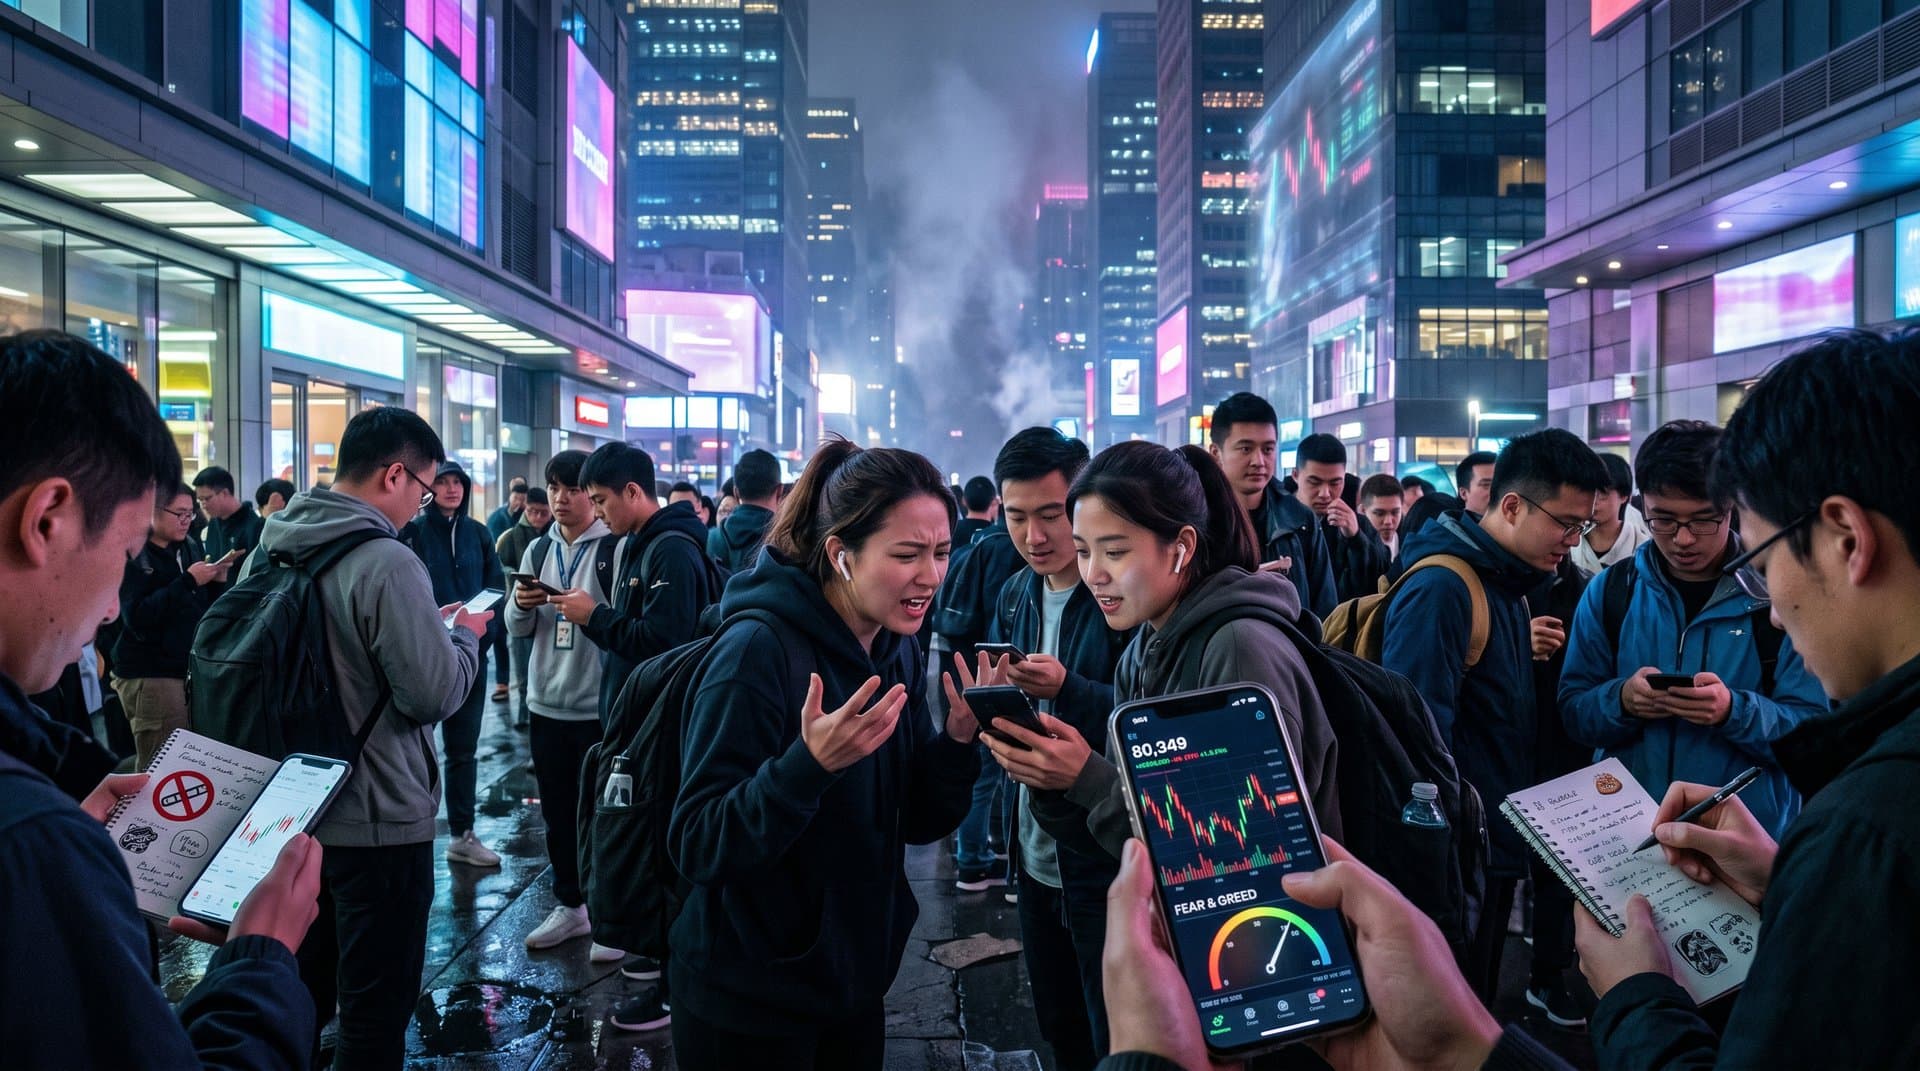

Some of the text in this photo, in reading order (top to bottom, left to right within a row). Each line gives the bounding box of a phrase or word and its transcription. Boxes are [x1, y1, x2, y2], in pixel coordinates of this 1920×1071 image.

[1131, 736, 1188, 759] 80,349
[1174, 888, 1258, 916] FEAR & GREED
